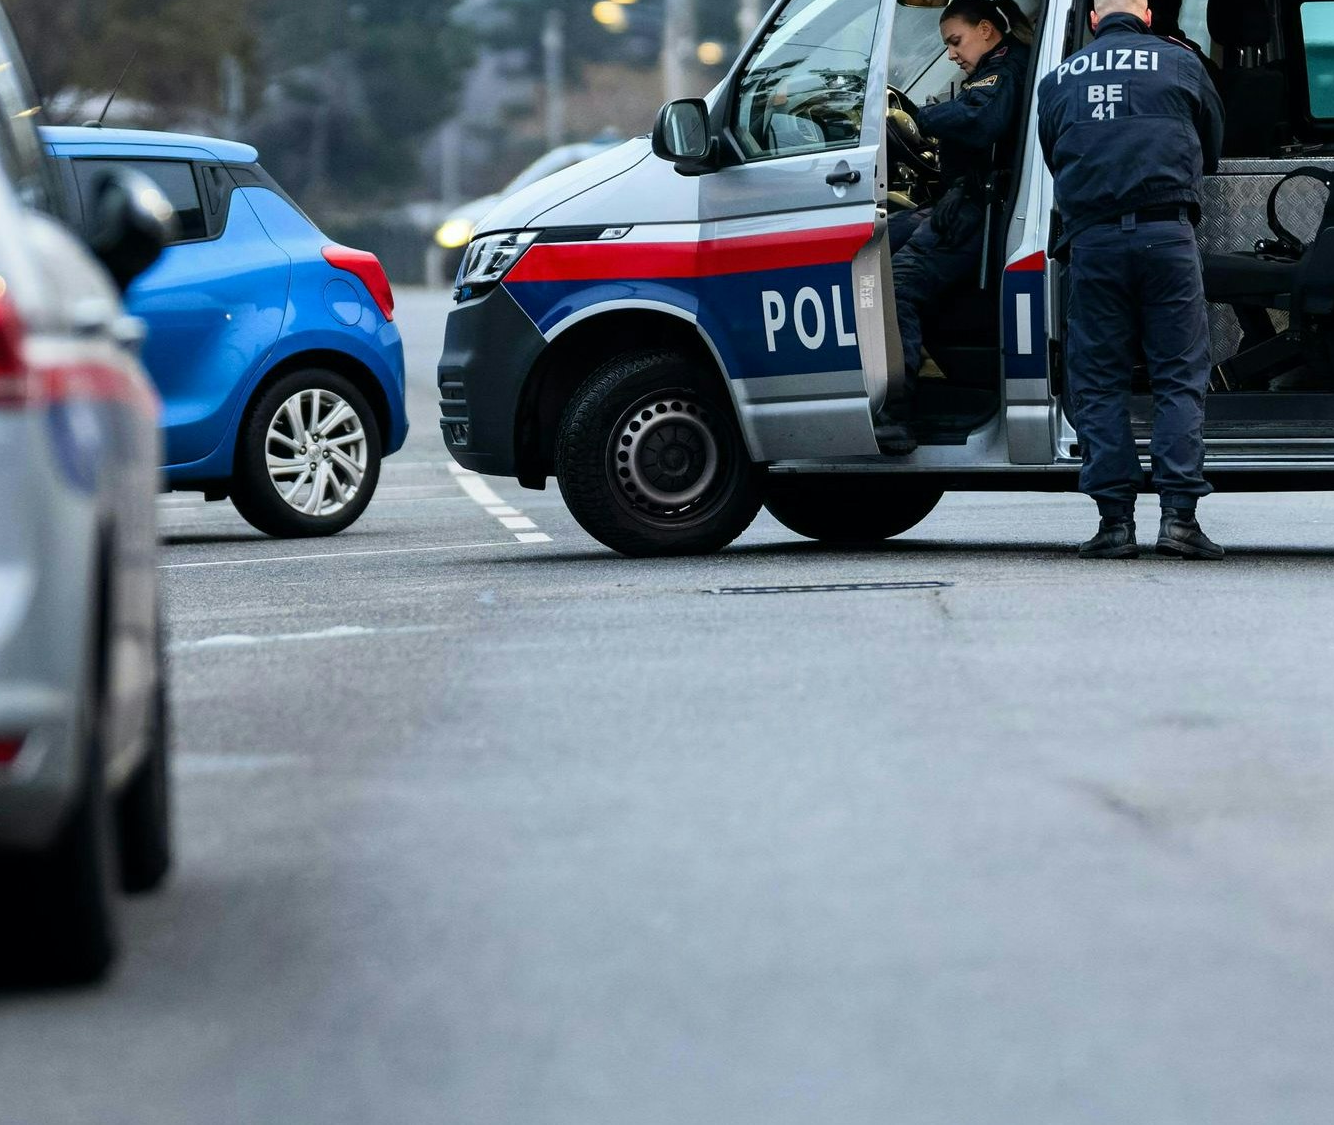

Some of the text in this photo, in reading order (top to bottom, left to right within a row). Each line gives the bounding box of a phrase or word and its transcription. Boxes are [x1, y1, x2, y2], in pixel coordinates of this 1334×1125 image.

[1056, 48, 1159, 85] POLIZEI
[1087, 83, 1123, 103] BE
[1091, 102, 1116, 121] 41
